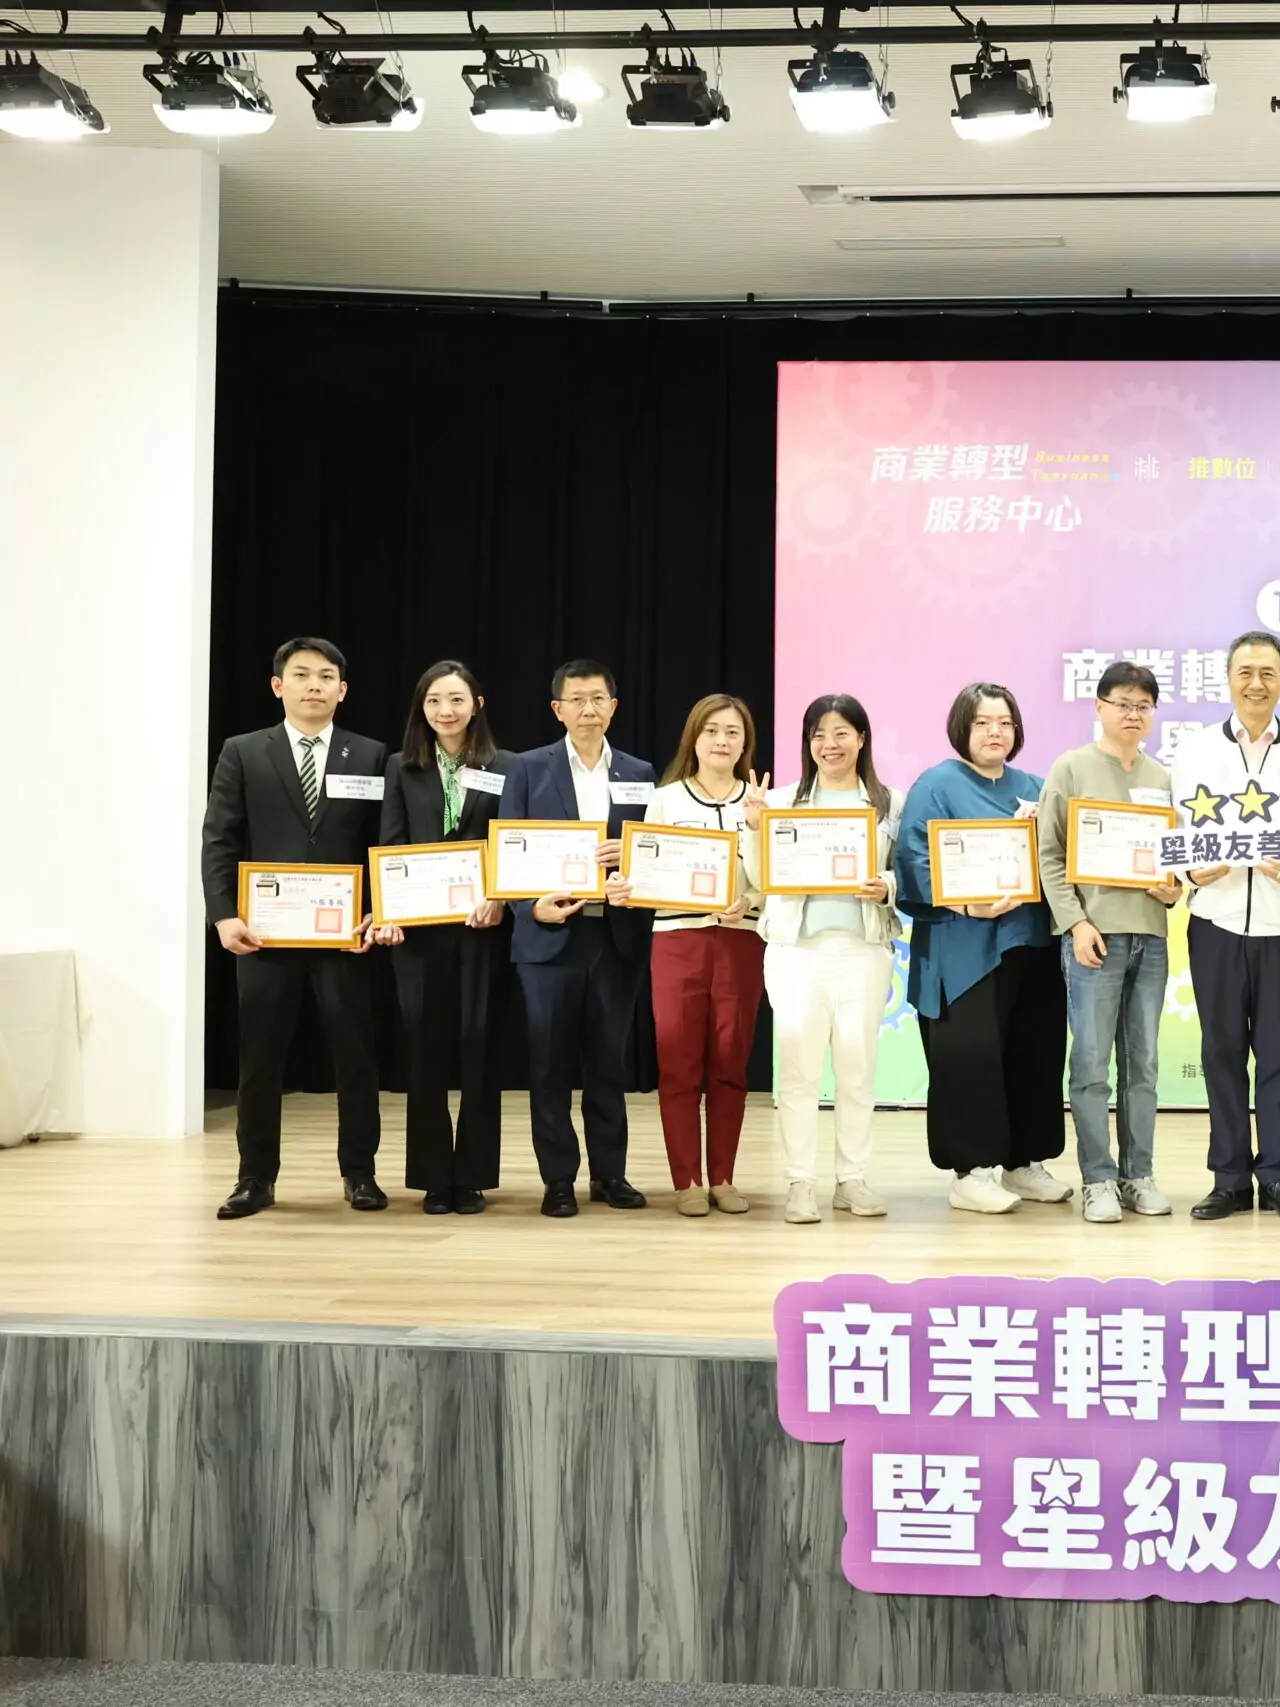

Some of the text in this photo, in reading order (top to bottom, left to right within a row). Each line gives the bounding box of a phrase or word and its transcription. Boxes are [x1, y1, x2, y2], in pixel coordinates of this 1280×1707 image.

[870, 443, 1030, 483] 商業轉型
[1188, 456, 1257, 481] 推數位
[922, 494, 1082, 534] 服務中心
